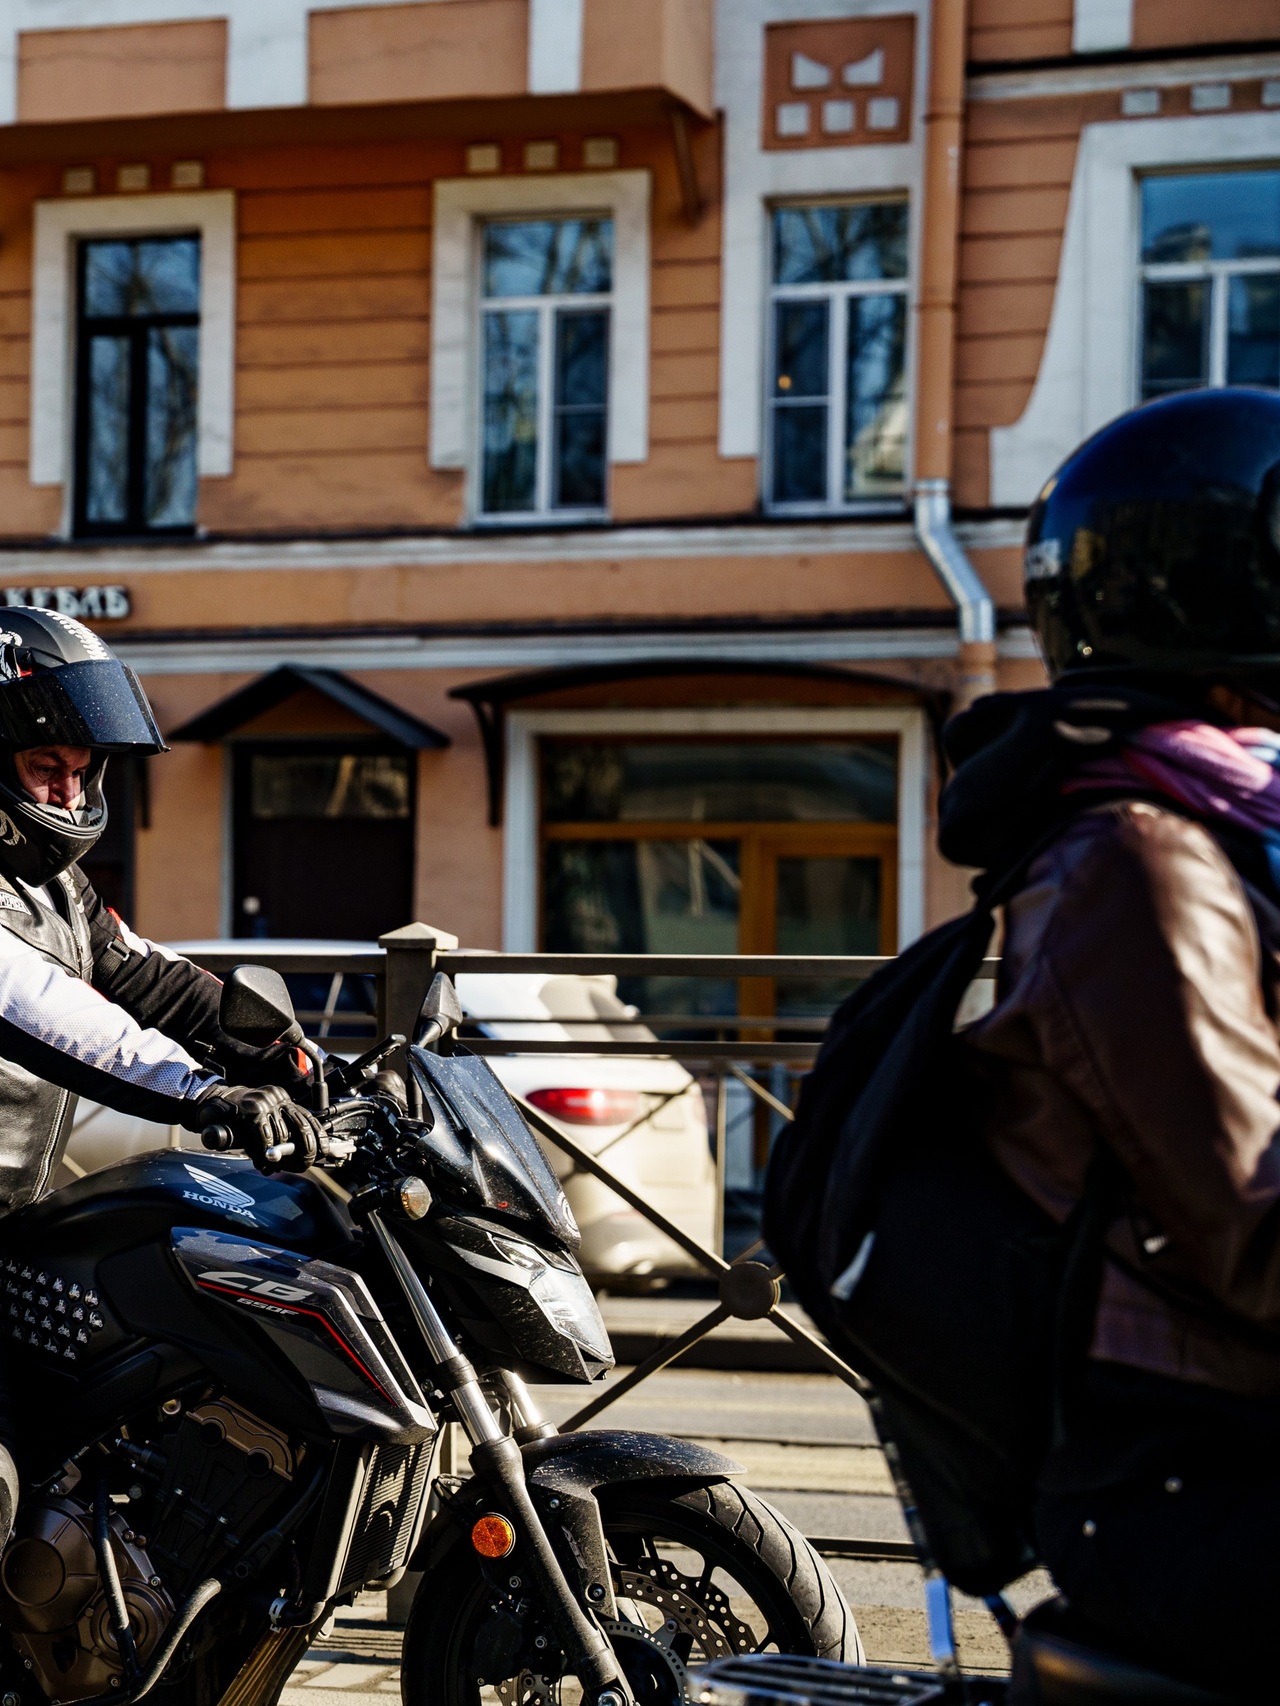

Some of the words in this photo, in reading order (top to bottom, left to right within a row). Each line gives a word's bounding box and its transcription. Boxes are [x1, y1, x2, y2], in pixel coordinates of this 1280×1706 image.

[183, 1190, 257, 1220] HONDA
[197, 1271, 314, 1302] CB
[237, 1297, 300, 1316] 650F
